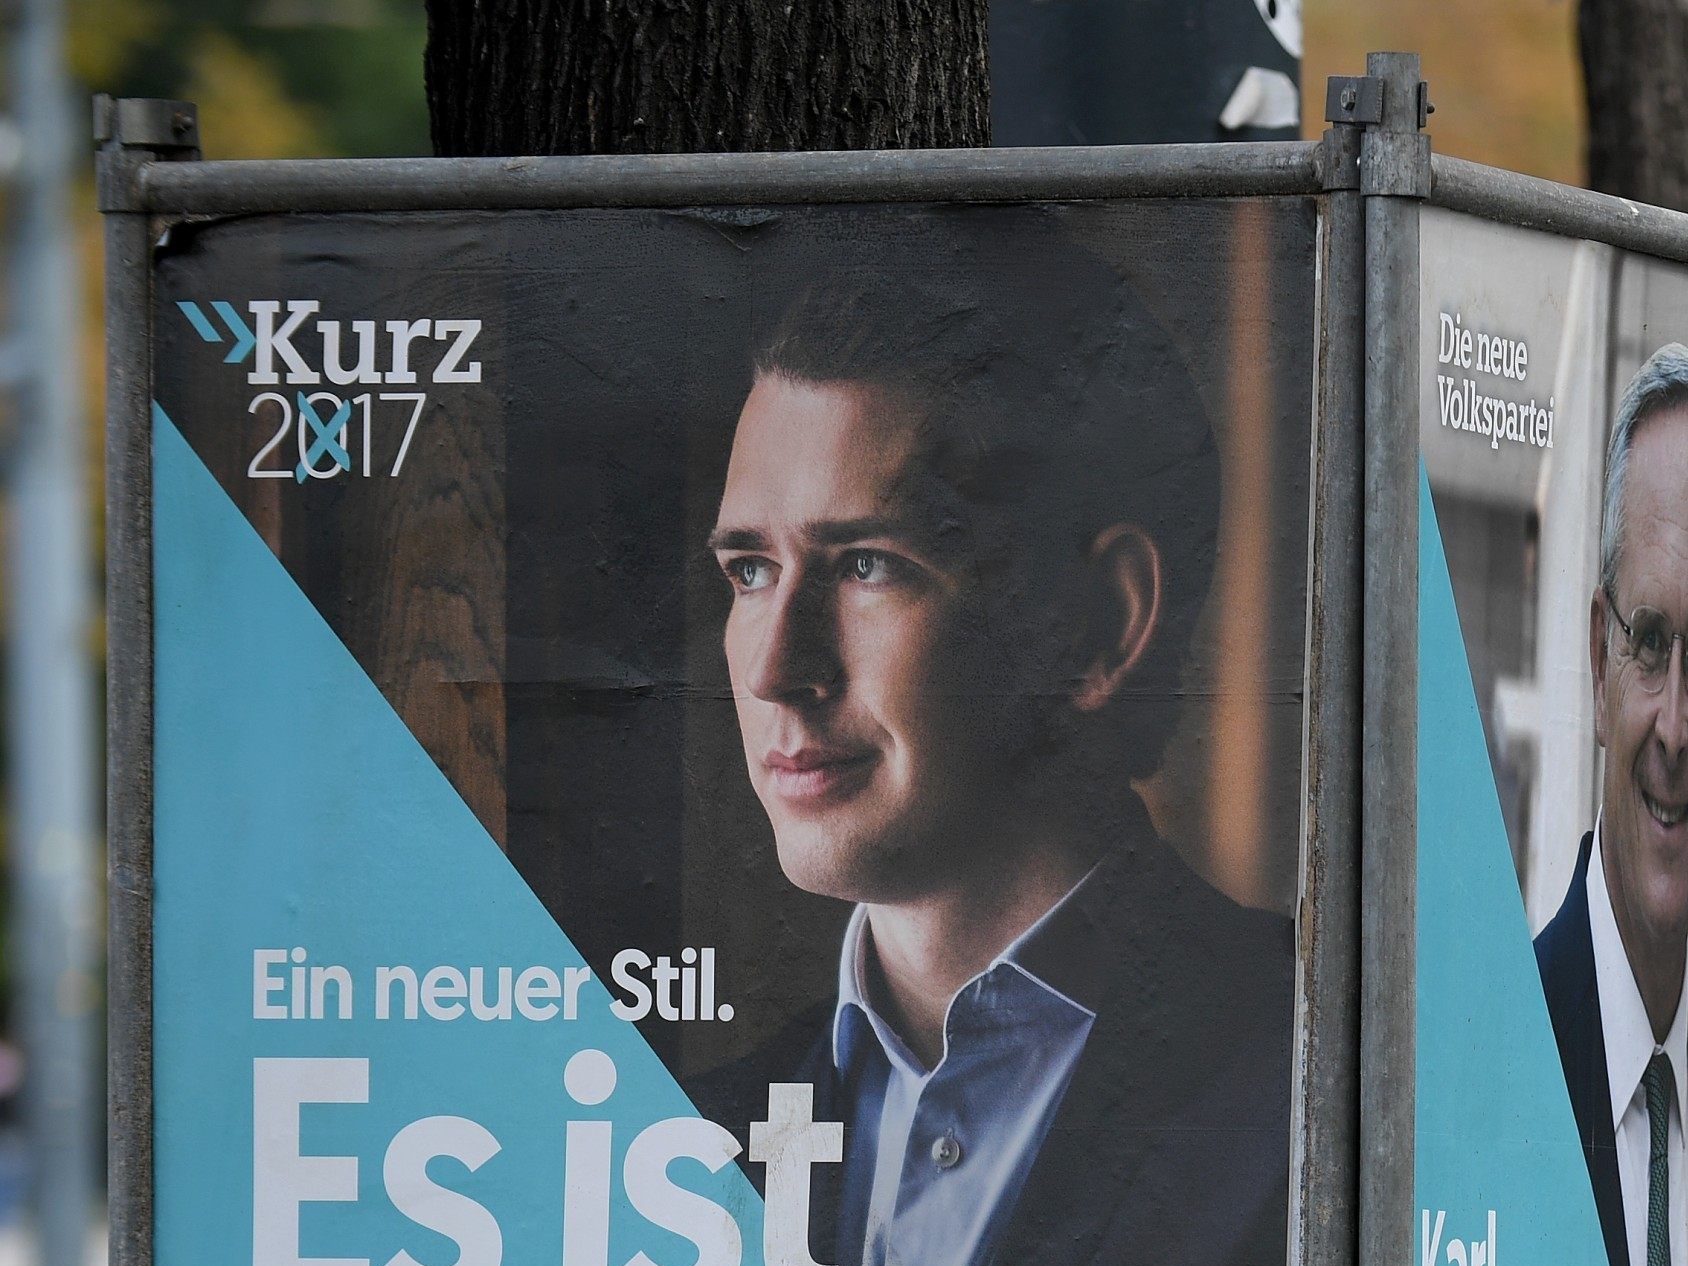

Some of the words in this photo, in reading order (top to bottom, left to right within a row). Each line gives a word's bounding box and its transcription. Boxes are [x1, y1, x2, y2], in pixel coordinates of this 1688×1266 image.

[247, 299, 482, 385] Kurz
[1438, 311, 1473, 369] Die
[1475, 331, 1529, 381] neue
[247, 391, 427, 483] 2017
[1437, 374, 1555, 450] Volkspartei
[252, 947, 353, 1020] Ein
[375, 955, 591, 1022] neuer
[609, 947, 735, 1022] Stil.
